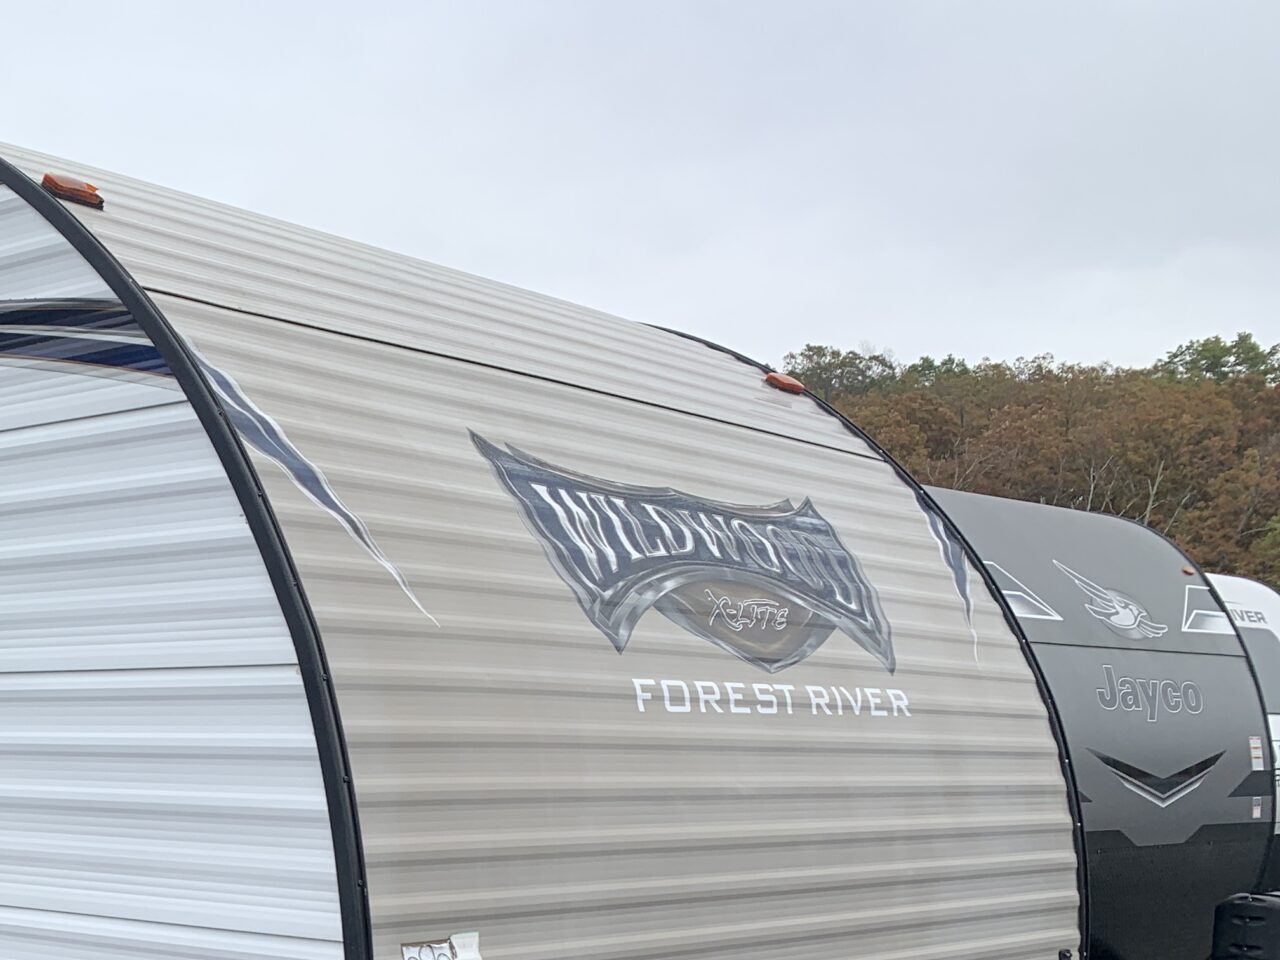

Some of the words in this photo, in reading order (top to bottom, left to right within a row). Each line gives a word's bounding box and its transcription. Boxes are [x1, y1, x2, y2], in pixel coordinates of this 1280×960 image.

[531, 482, 858, 610] WILDWOOD
[704, 588, 790, 632] X-LITE
[631, 678, 796, 715] FOREST
[805, 685, 913, 718] RIVER
[1096, 664, 1204, 722] Jayco
